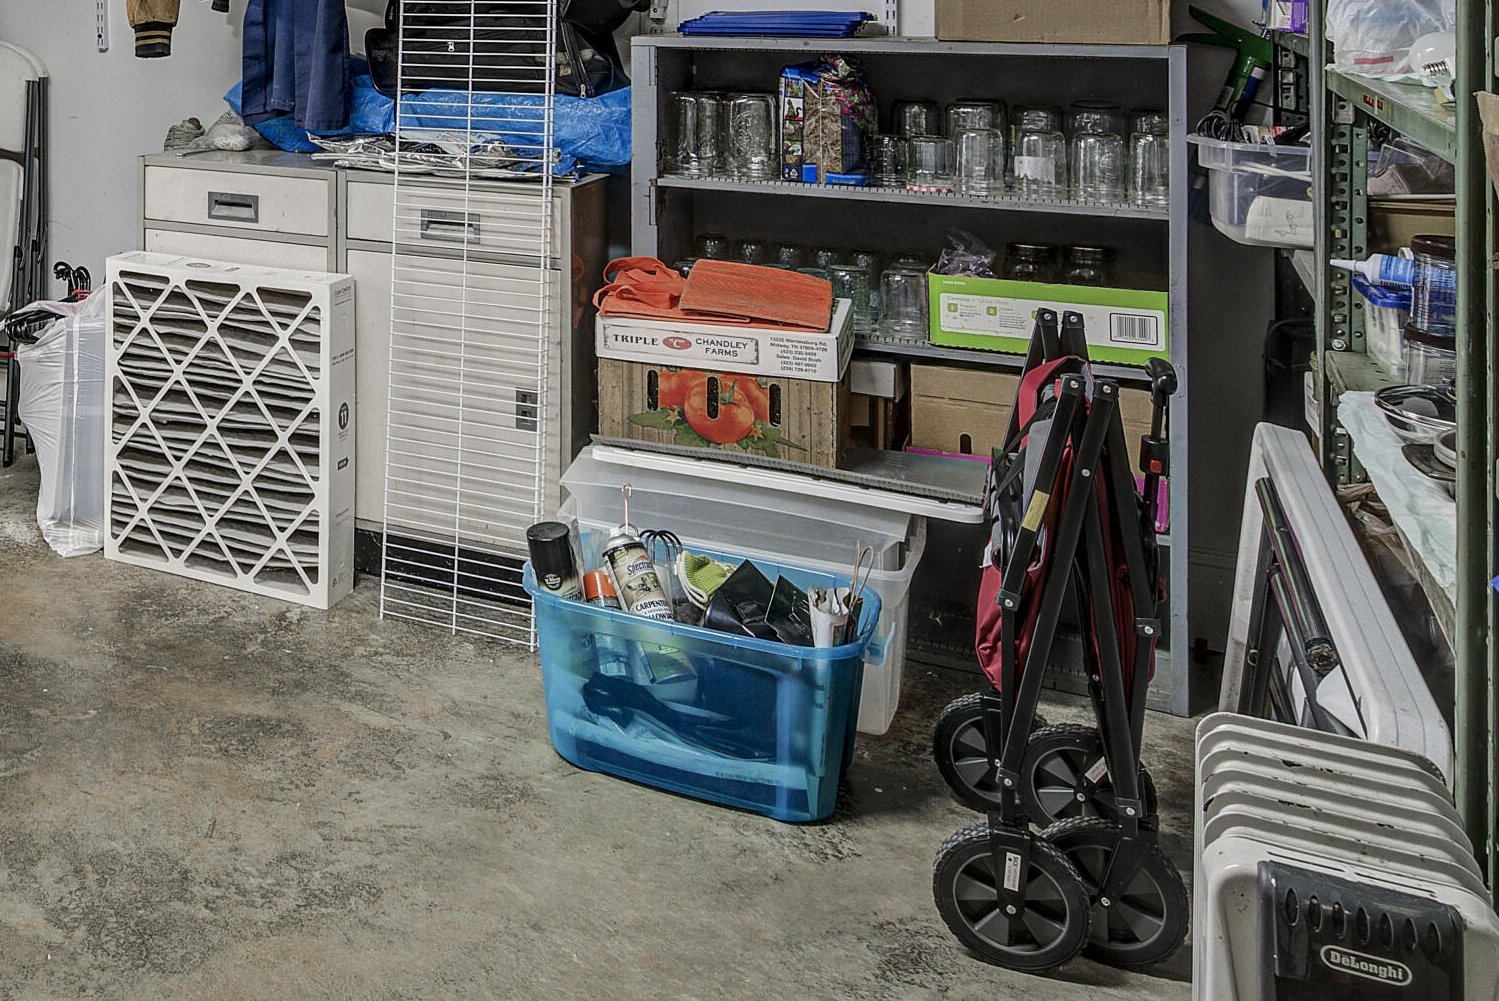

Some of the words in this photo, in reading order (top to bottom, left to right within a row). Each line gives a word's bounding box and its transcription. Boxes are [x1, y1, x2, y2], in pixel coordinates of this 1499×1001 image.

[613, 334, 659, 346] TRIPLE
[696, 337, 748, 349] CHANDLEY
[705, 348, 739, 357] FARMS
